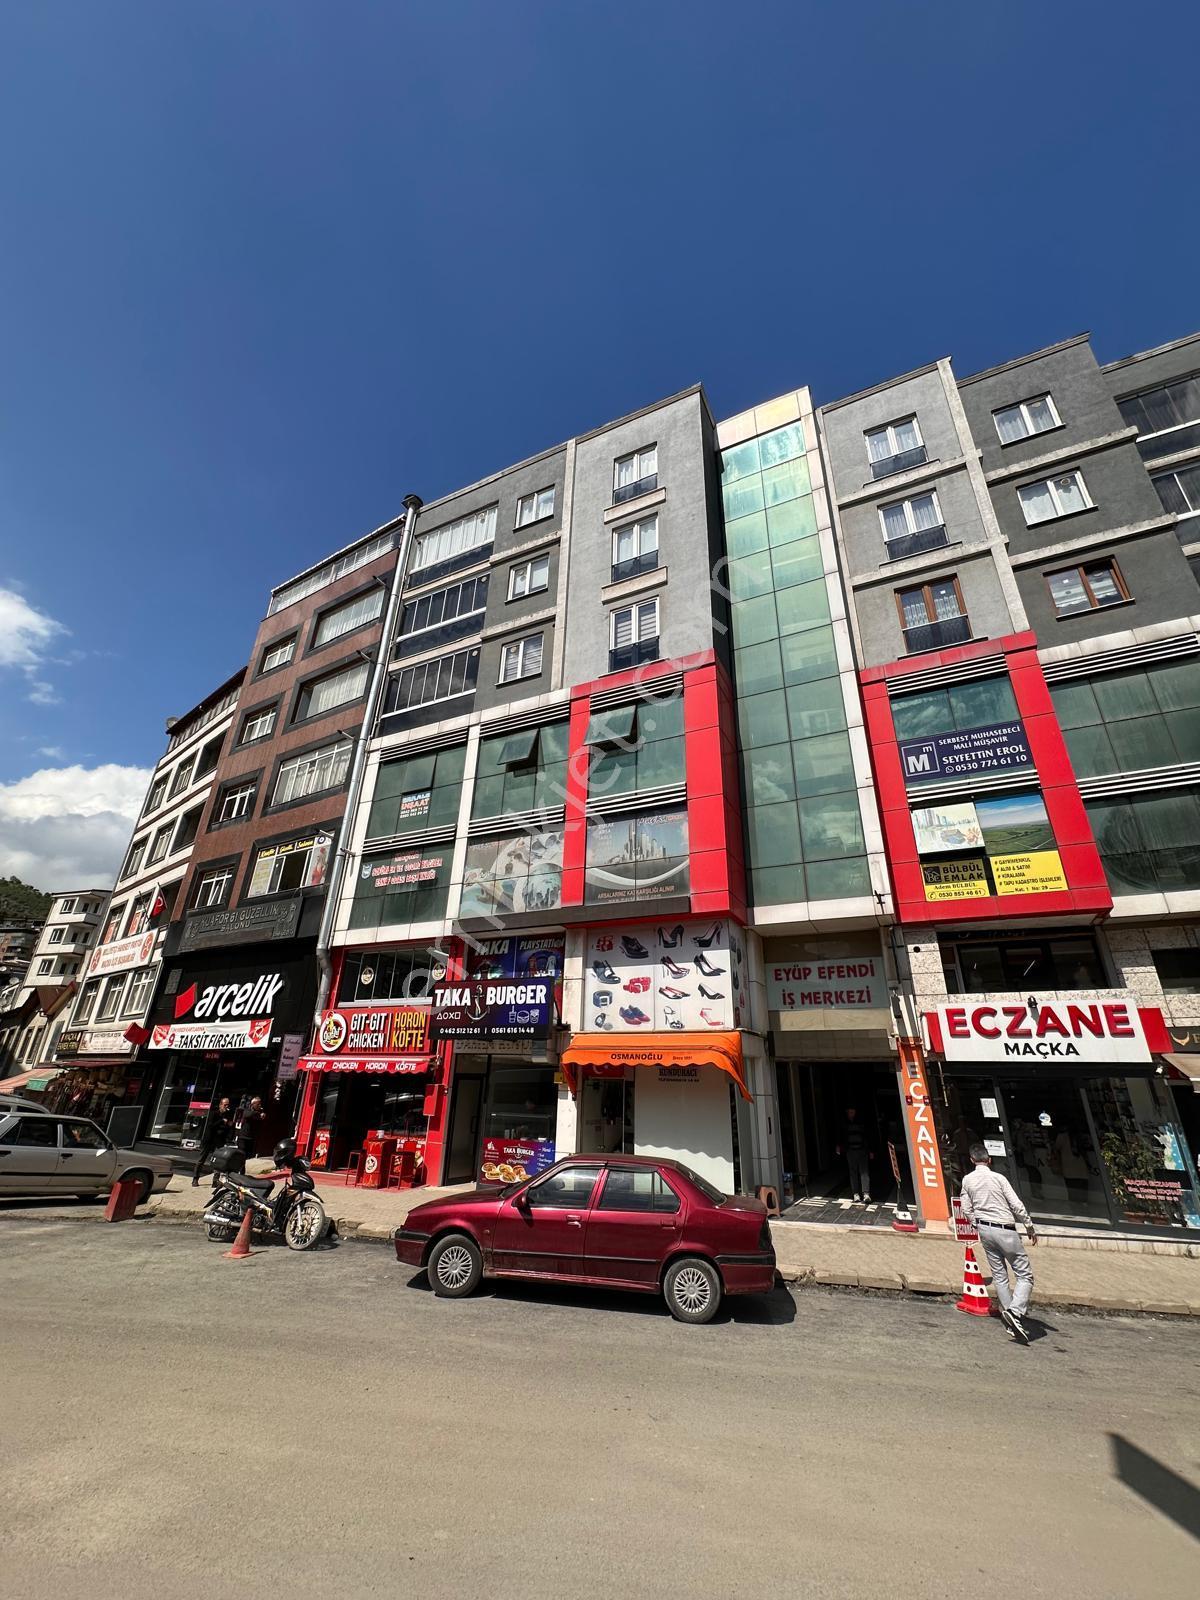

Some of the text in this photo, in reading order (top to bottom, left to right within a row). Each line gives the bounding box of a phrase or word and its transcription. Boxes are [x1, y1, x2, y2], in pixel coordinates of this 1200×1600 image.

[938, 725, 1021, 746] SERBEST MUHASEBECİ
[953, 735, 1009, 751] MALİ MÜŞAVİR
[997, 744, 1026, 757] EROL
[955, 754, 1028, 772] 0530 774 61 10
[942, 863, 983, 874] BÜLBÜL
[943, 872, 984, 883] EMLAK
[475, 938, 566, 956] TAKA PLAYSTATION
[774, 959, 875, 982] EYÜP EFENDİ
[435, 983, 547, 1007] TAKA BURGER
[782, 985, 872, 1009] İŞ MERKEZİ
[351, 1012, 388, 1031] GIT-GIT
[394, 1011, 427, 1029] HORON
[945, 1003, 1135, 1039] ECZANE
[168, 1033, 176, 1047] 9
[178, 1031, 210, 1049] TAKSİT
[208, 1033, 247, 1048] FIRSATI!
[348, 1032, 385, 1048] CHICKEN
[392, 1027, 425, 1048] KÖFTE
[1004, 1042, 1080, 1059] MAÇKA
[306, 1060, 417, 1071] GIT-GIT CHICKEN HORON KÖFTE
[906, 1062, 938, 1187] ECZANE
[516, 1147, 535, 1157] BURGER
